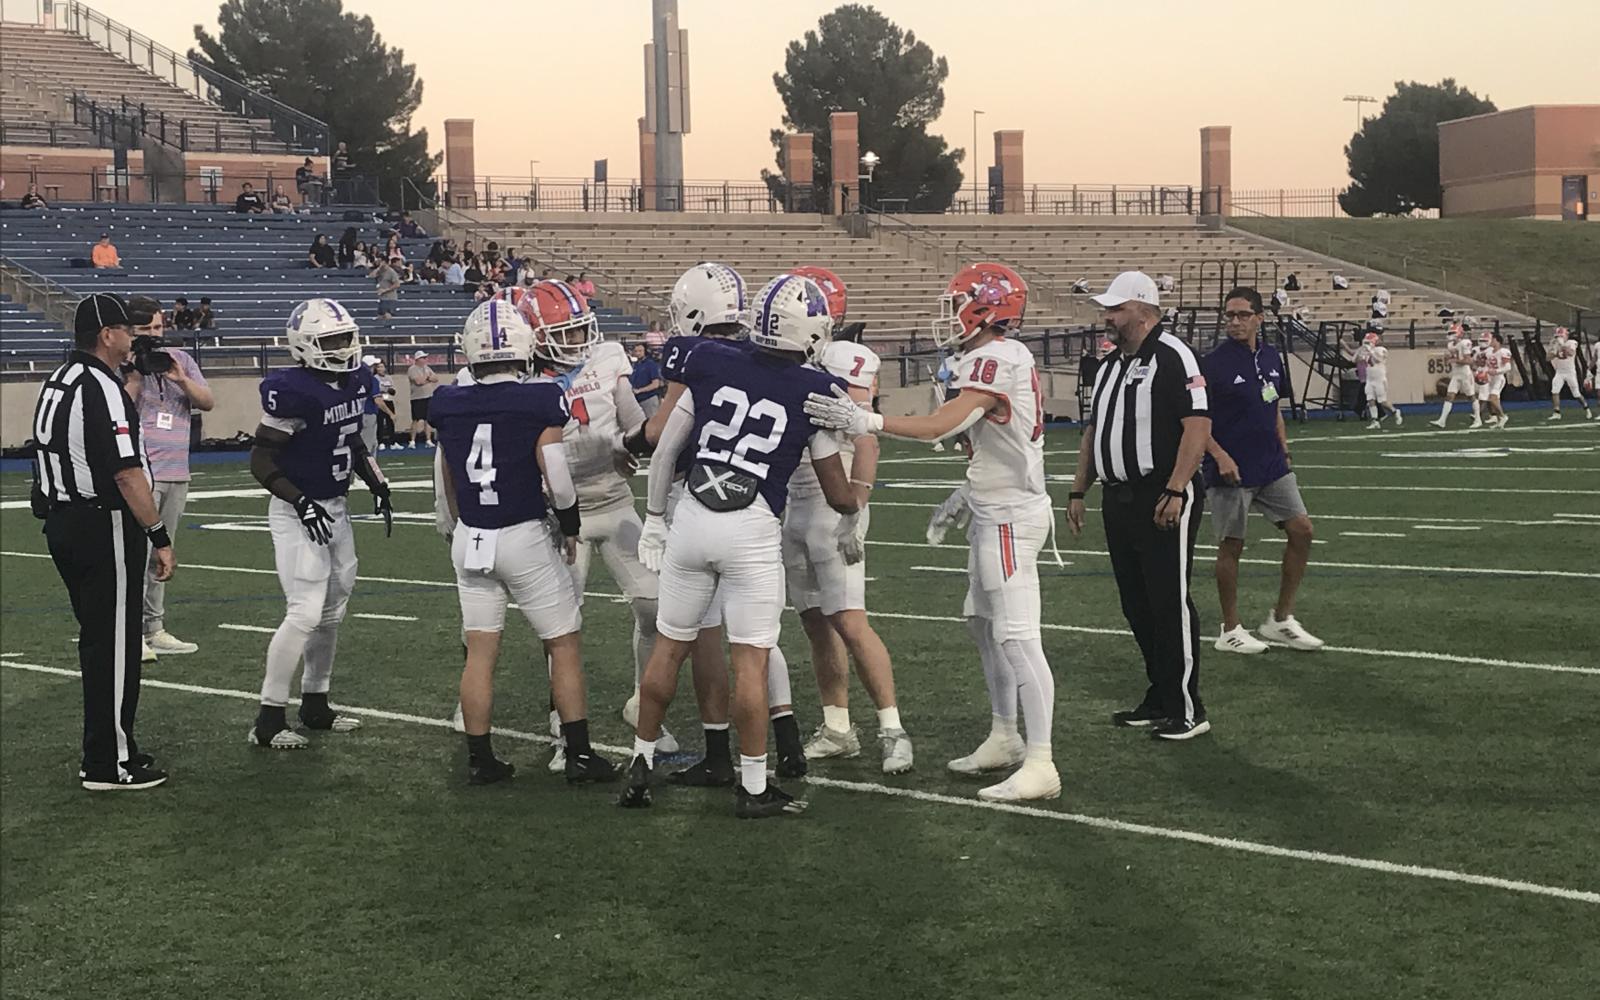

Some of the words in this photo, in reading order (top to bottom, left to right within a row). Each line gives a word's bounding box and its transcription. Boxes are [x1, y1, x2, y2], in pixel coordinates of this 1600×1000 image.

[498, 327, 508, 342] 4
[849, 356, 866, 377] 7
[969, 357, 998, 384] 18
[267, 390, 278, 410] 5
[322, 396, 368, 425] MIDLAN
[36, 387, 65, 445] U
[696, 385, 788, 480] 22
[331, 422, 359, 482] 5
[465, 423, 499, 505] 4
